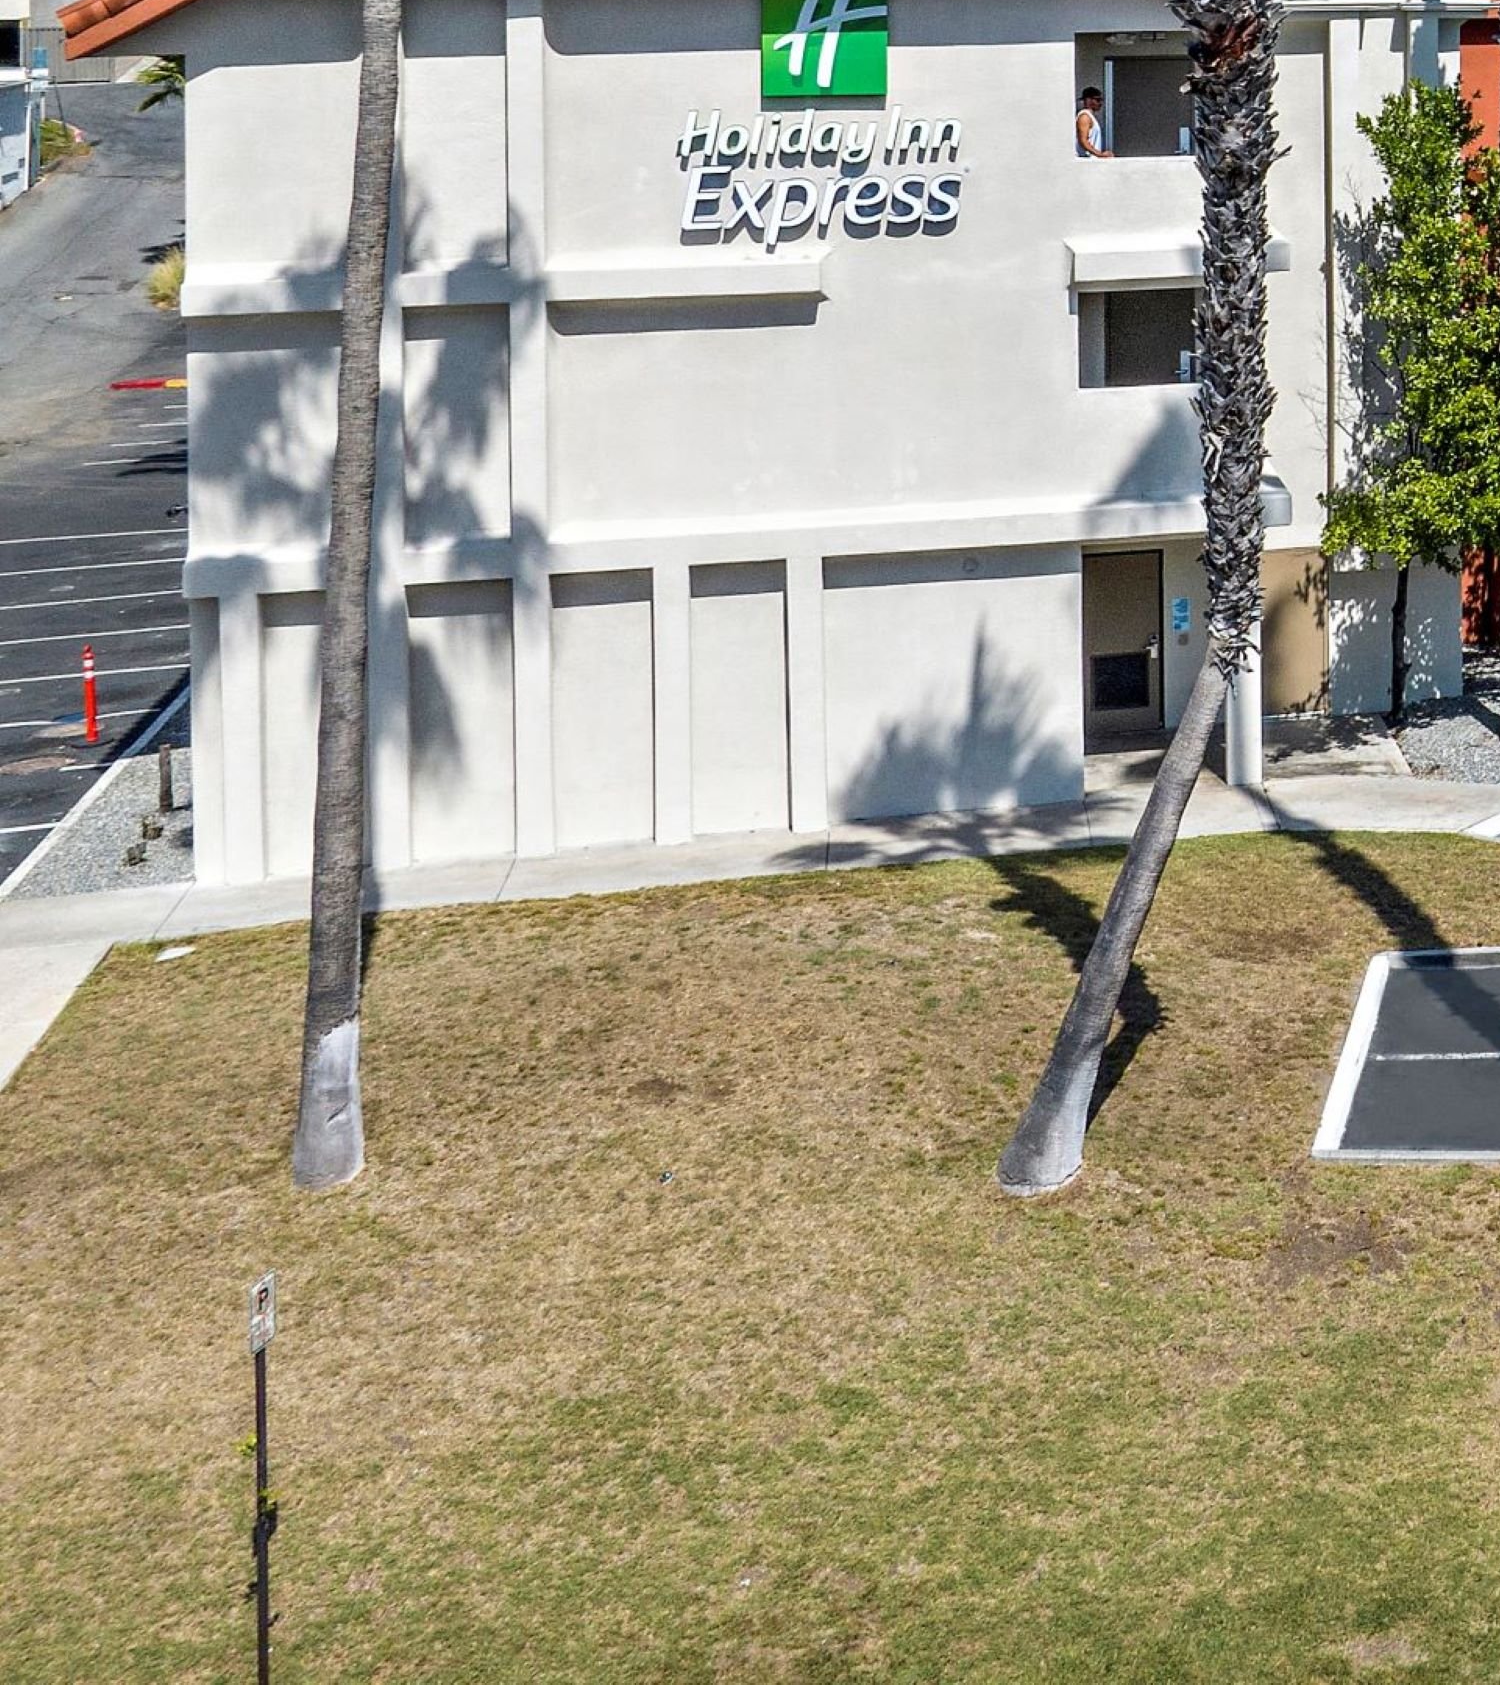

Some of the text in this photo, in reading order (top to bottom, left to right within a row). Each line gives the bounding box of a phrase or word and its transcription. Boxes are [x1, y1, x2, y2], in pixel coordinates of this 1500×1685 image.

[676, 104, 961, 164] Holiday Inn
[680, 166, 962, 246] Express
